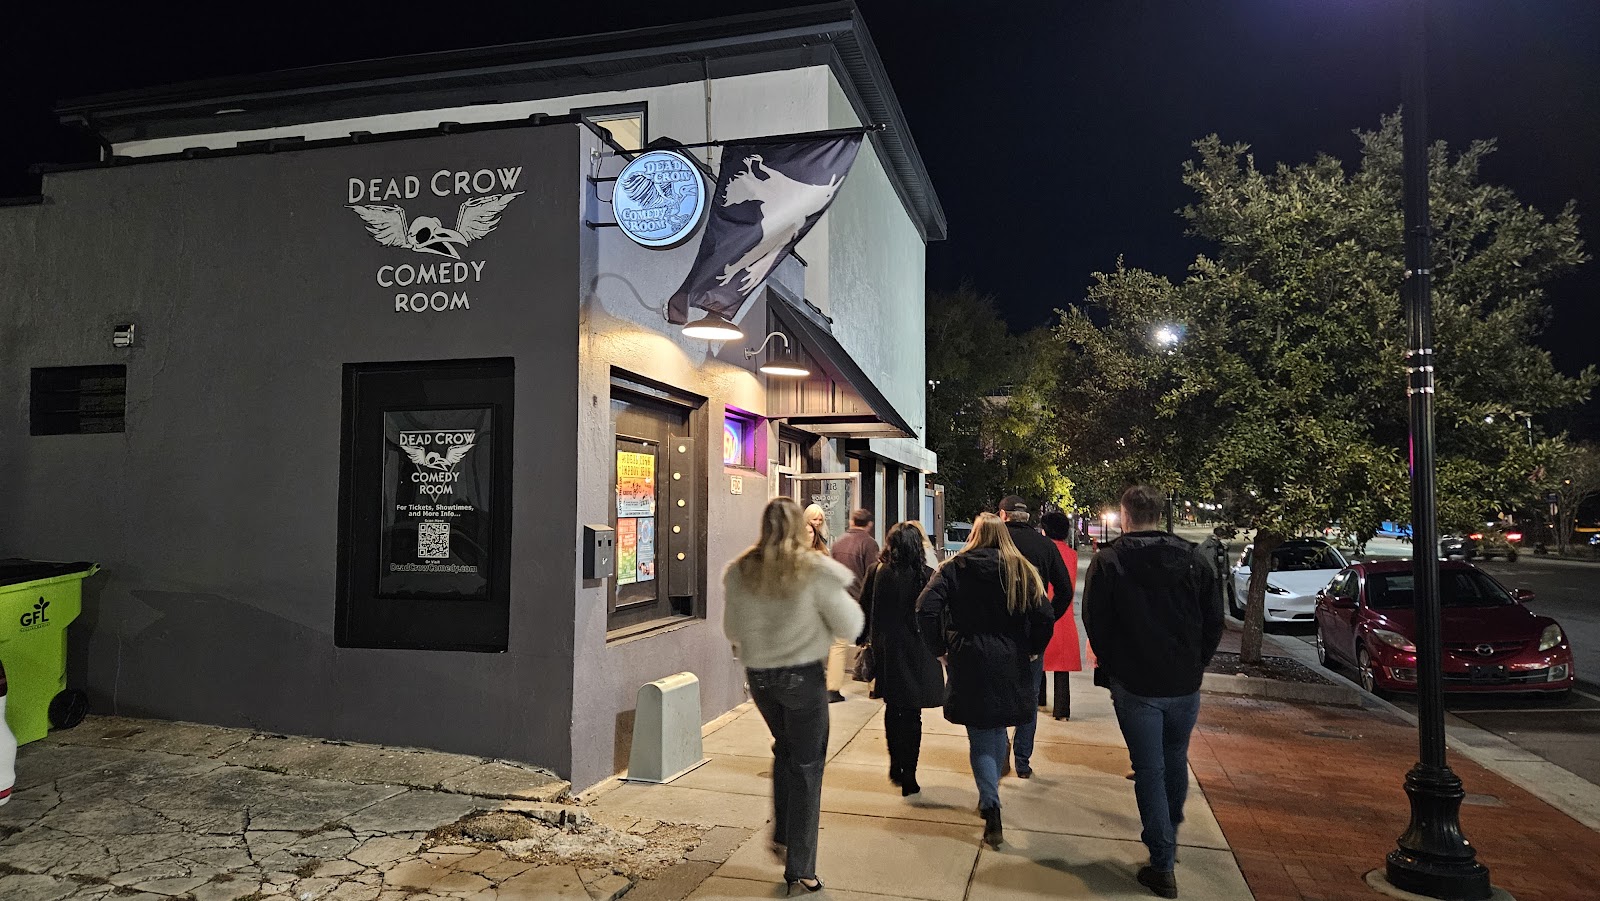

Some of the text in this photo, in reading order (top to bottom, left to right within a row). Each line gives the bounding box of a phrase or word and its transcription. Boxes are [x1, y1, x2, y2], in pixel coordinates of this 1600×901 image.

[645, 160, 692, 184] DEAD CROW
[348, 167, 522, 203] DEAD CROW
[622, 207, 667, 221] COMEDY
[629, 218, 667, 232] ROOM
[376, 260, 486, 287] COMEDY
[395, 291, 470, 313] ROOM
[399, 432, 476, 446] DEAD CROW
[411, 472, 460, 483] COMEDY
[420, 484, 453, 495] ROOM
[389, 562, 478, 574] DeadCrowComedy.com
[20, 602, 50, 627] GFL
